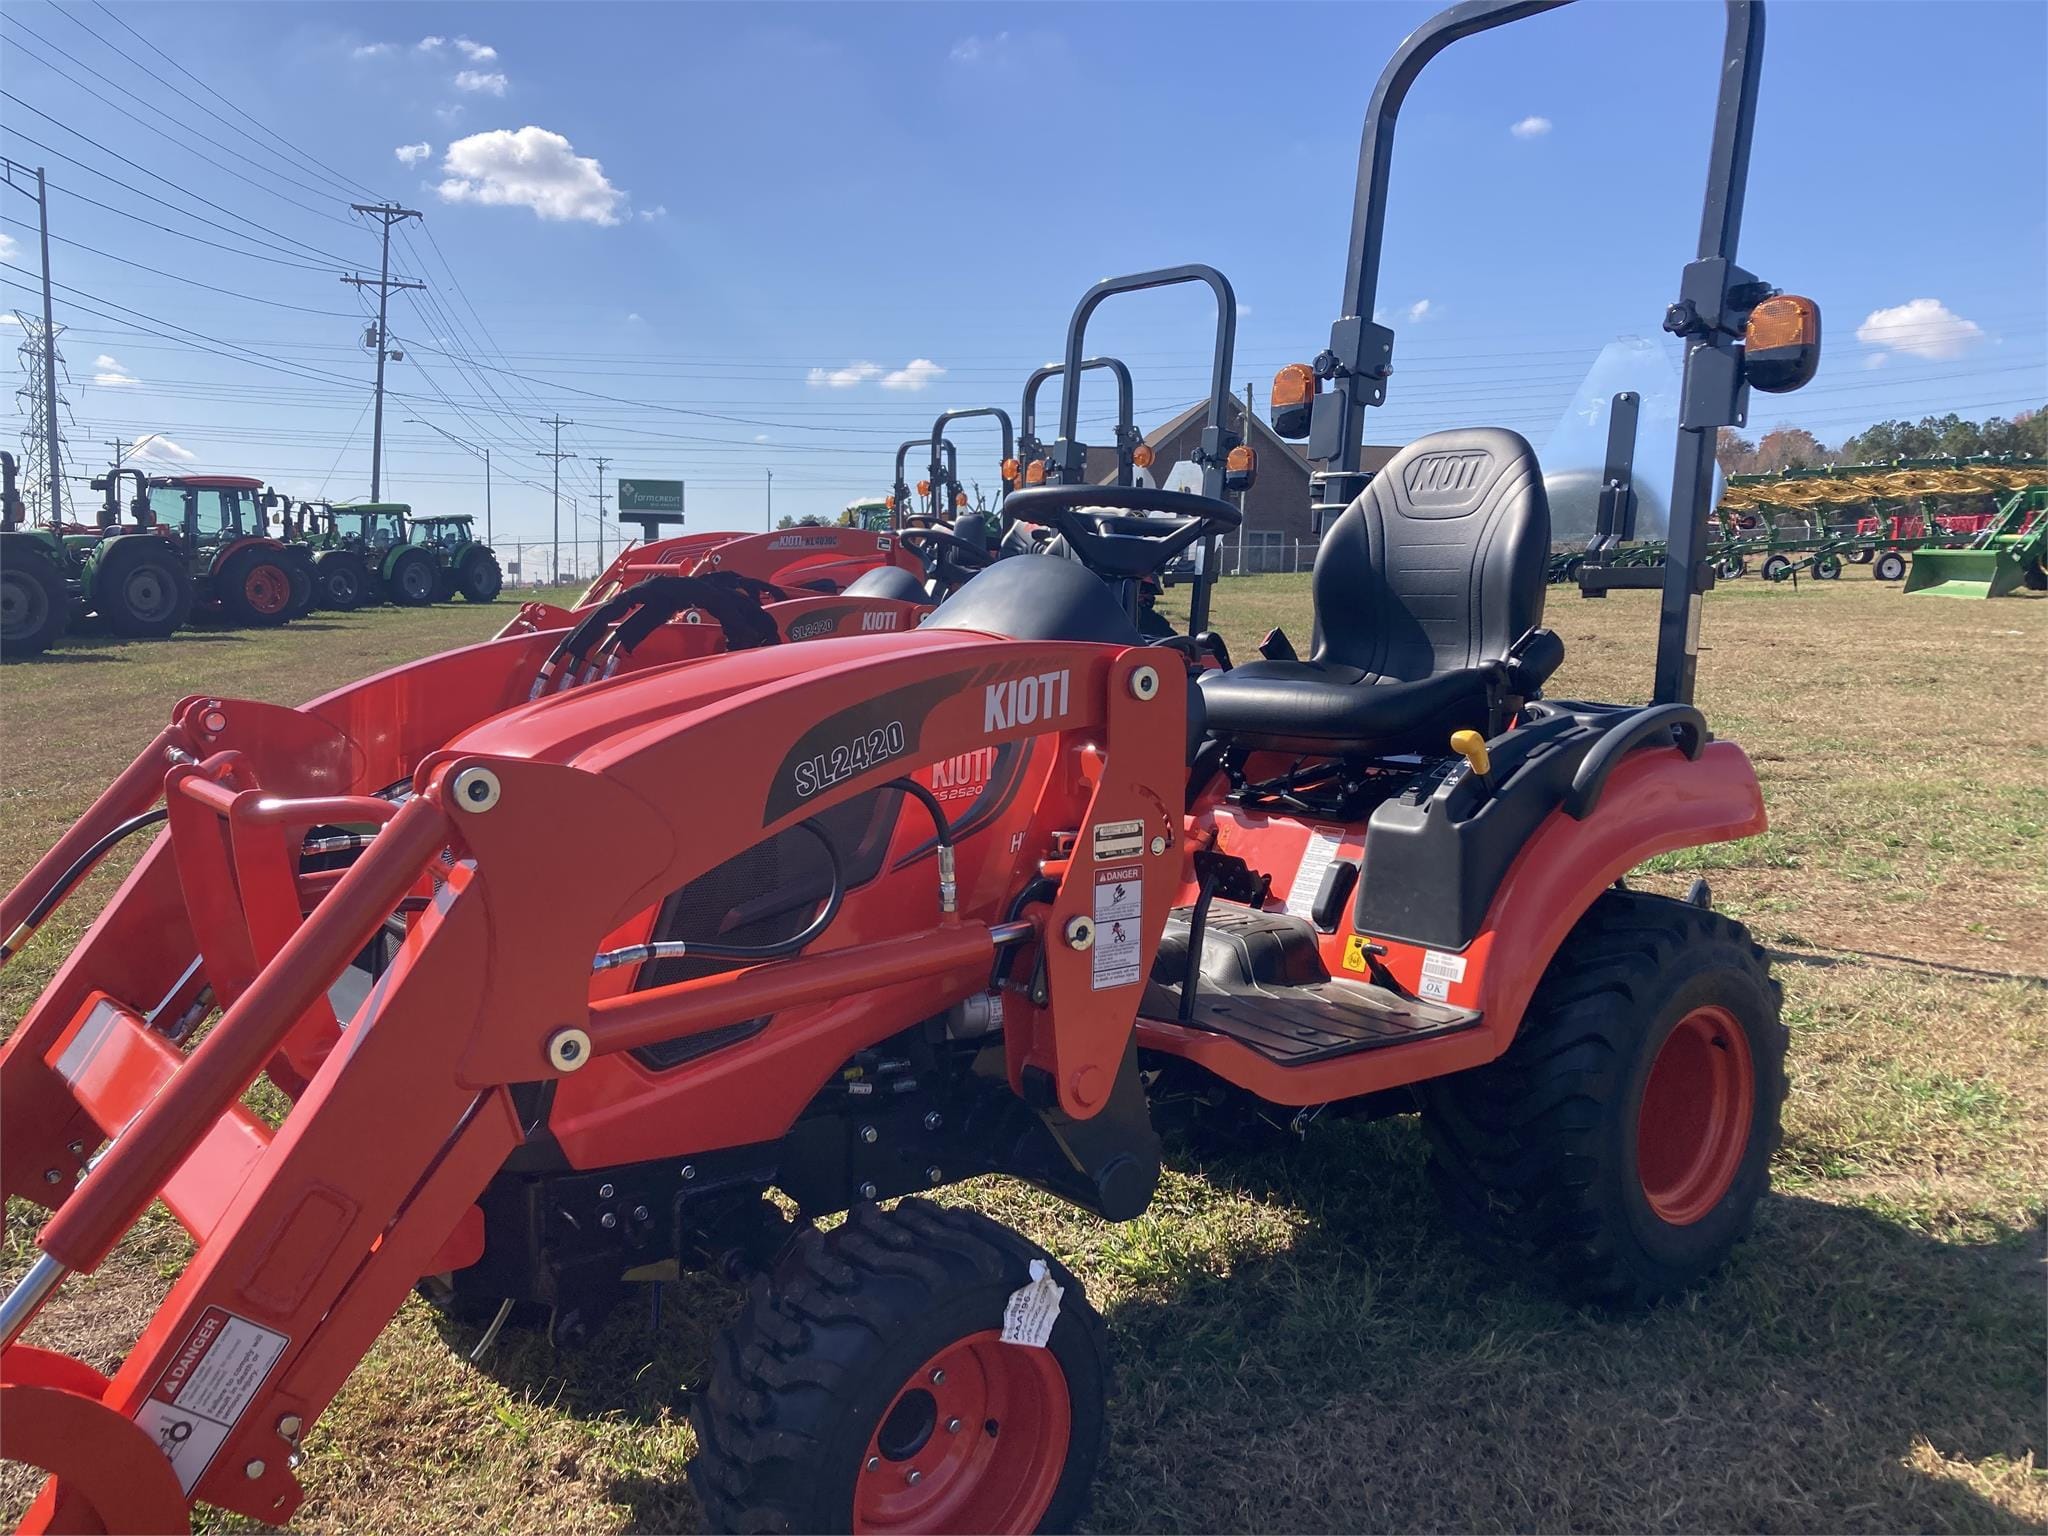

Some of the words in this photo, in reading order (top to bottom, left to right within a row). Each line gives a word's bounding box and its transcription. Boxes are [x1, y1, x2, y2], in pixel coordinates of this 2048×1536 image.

[1408, 453, 1487, 492] KIOTI
[779, 535, 802, 547] KIOTI
[792, 619, 833, 640] SL2420
[862, 611, 897, 631] KIOTI
[794, 720, 905, 798] SL2420
[983, 669, 1070, 733] KIOTI
[932, 746, 993, 789] KIOTI
[1106, 869, 1138, 881] DANGER
[1426, 983, 1441, 995] OK
[171, 1318, 219, 1378] DANGER
